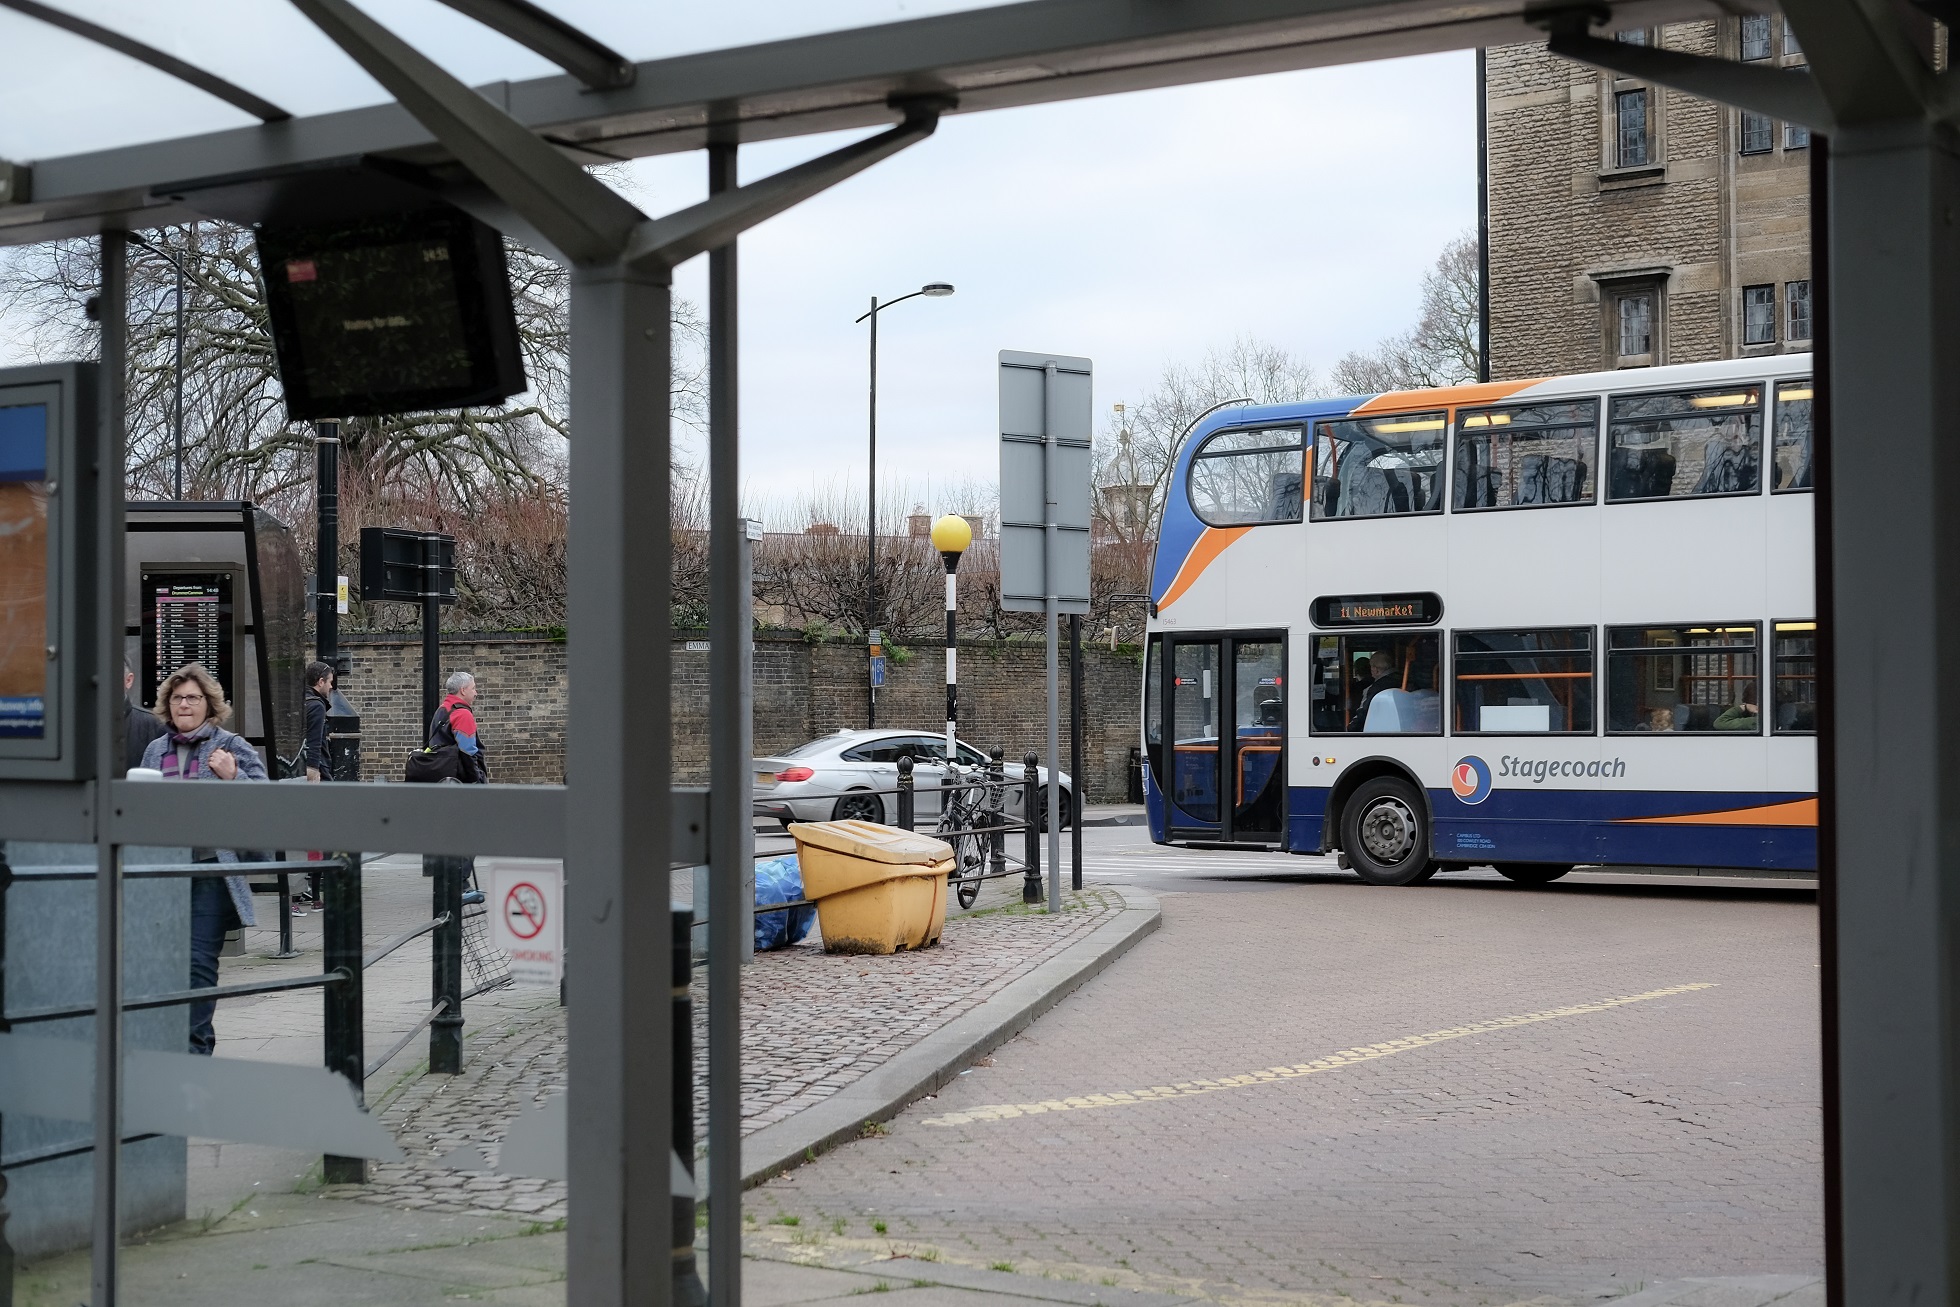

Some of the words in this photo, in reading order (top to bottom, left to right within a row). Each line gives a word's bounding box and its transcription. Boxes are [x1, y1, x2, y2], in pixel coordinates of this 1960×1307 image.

[1354, 604, 1413, 618] Newmarket
[688, 642, 711, 650] EMMA
[1498, 755, 1626, 784] Stagecoach
